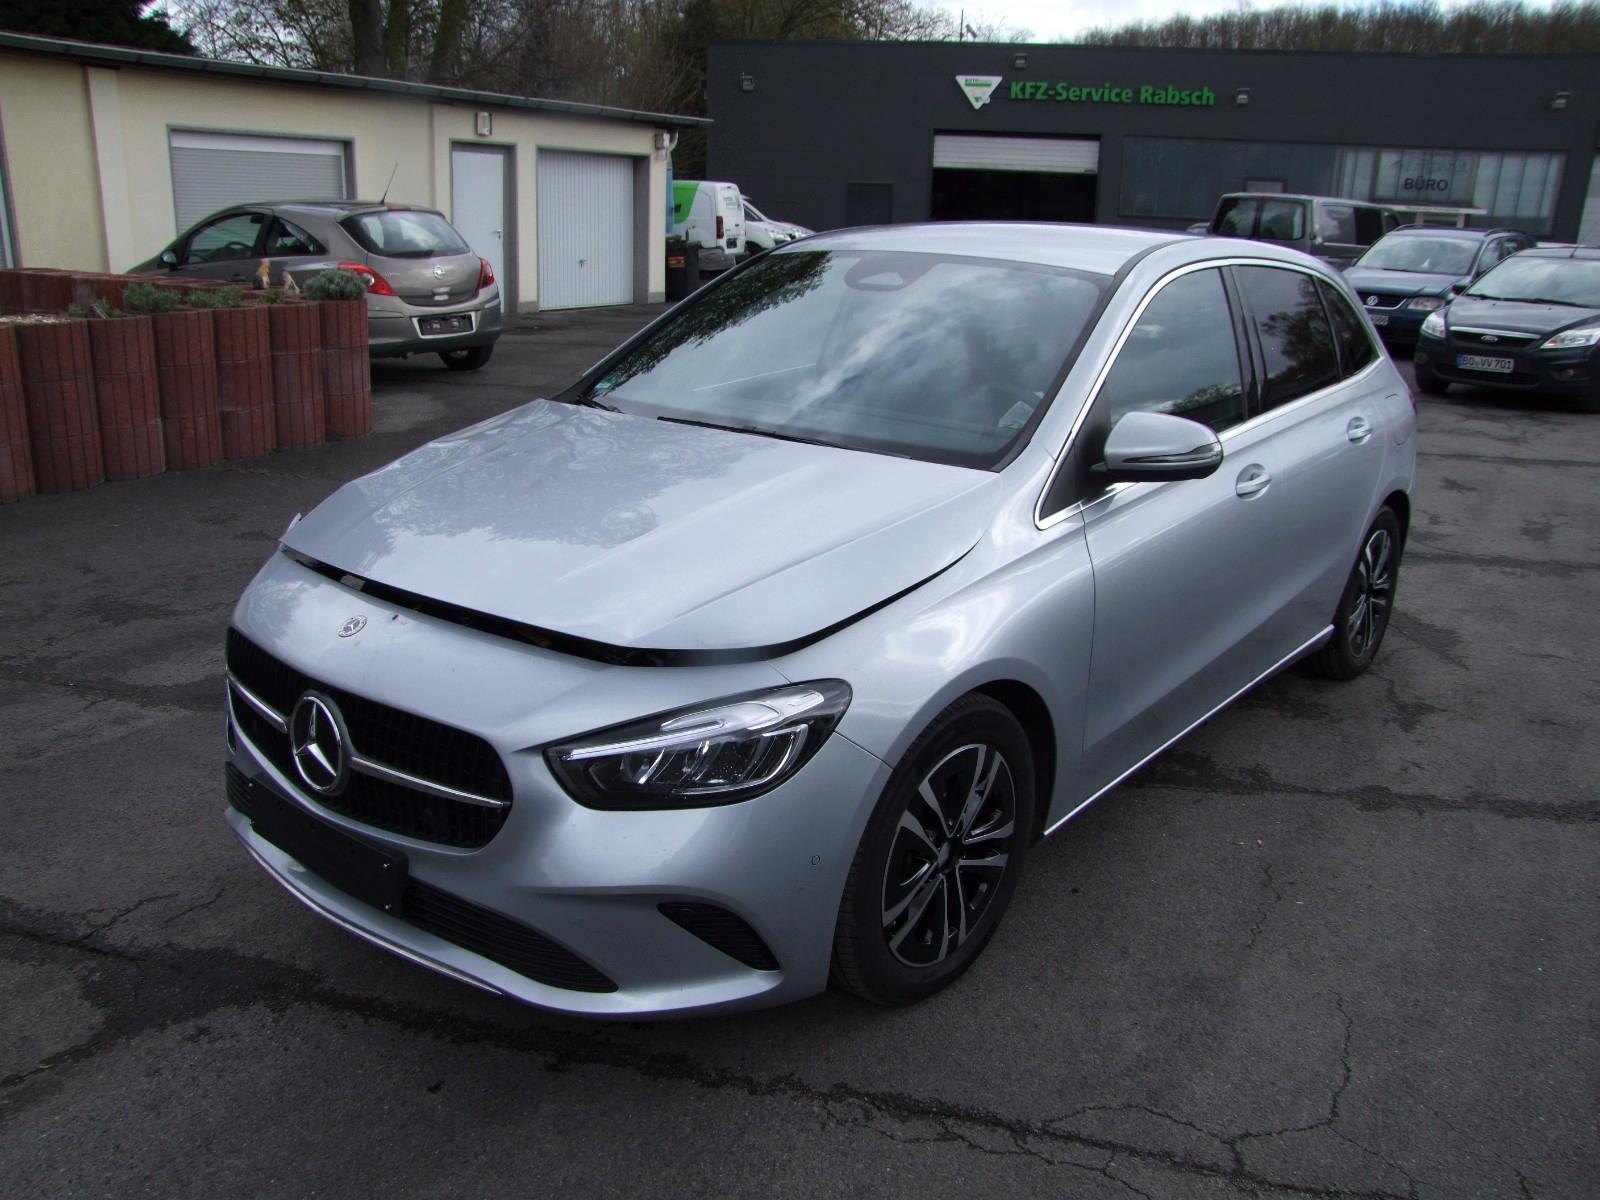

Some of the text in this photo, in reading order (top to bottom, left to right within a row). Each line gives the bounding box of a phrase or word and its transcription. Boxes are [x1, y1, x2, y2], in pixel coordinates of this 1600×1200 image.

[1010, 81, 1215, 105] KFZ-Service Rabsch
[1403, 176, 1449, 192] BÜRO
